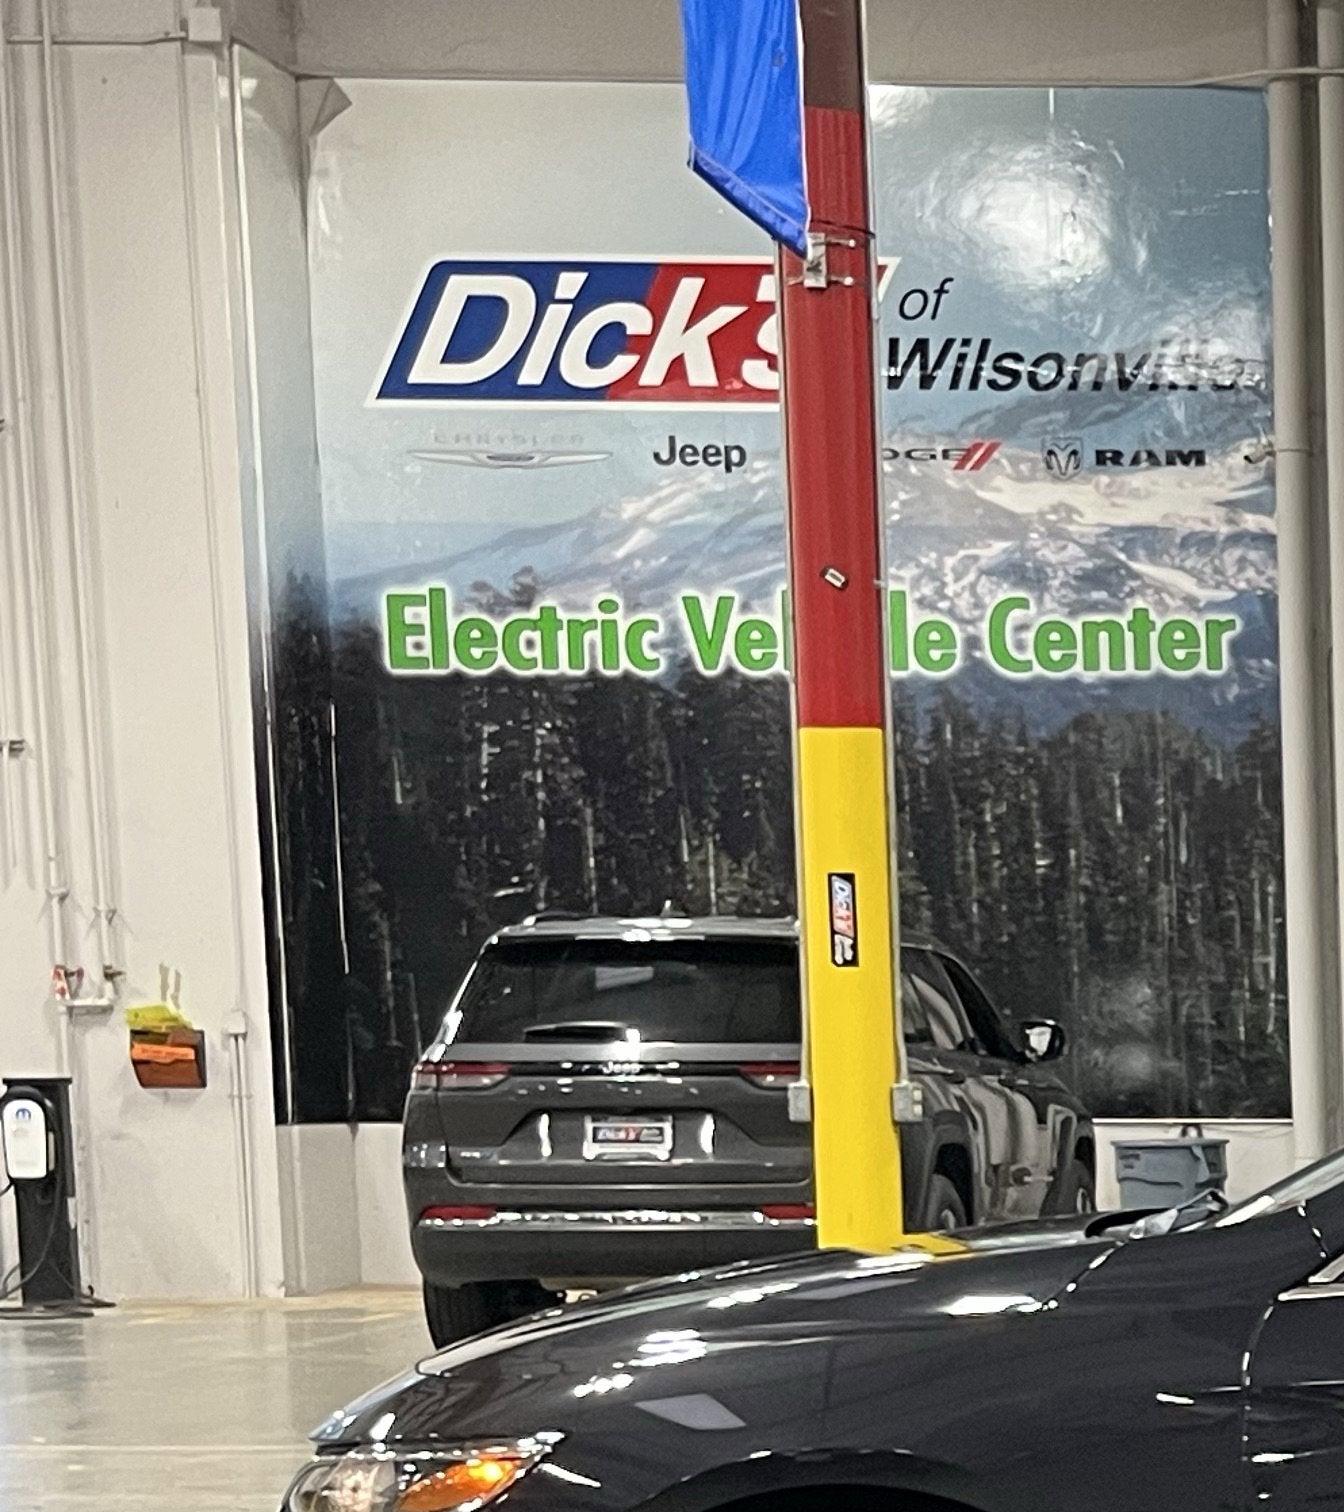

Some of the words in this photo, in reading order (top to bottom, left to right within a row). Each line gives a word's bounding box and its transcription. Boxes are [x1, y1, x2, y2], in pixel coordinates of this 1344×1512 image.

[898, 278, 954, 321] of
[653, 436, 748, 473] Jeep
[1094, 448, 1207, 467] RAM
[386, 587, 660, 671] Electric
[681, 588, 958, 672] Vele
[988, 597, 1237, 672] Center
